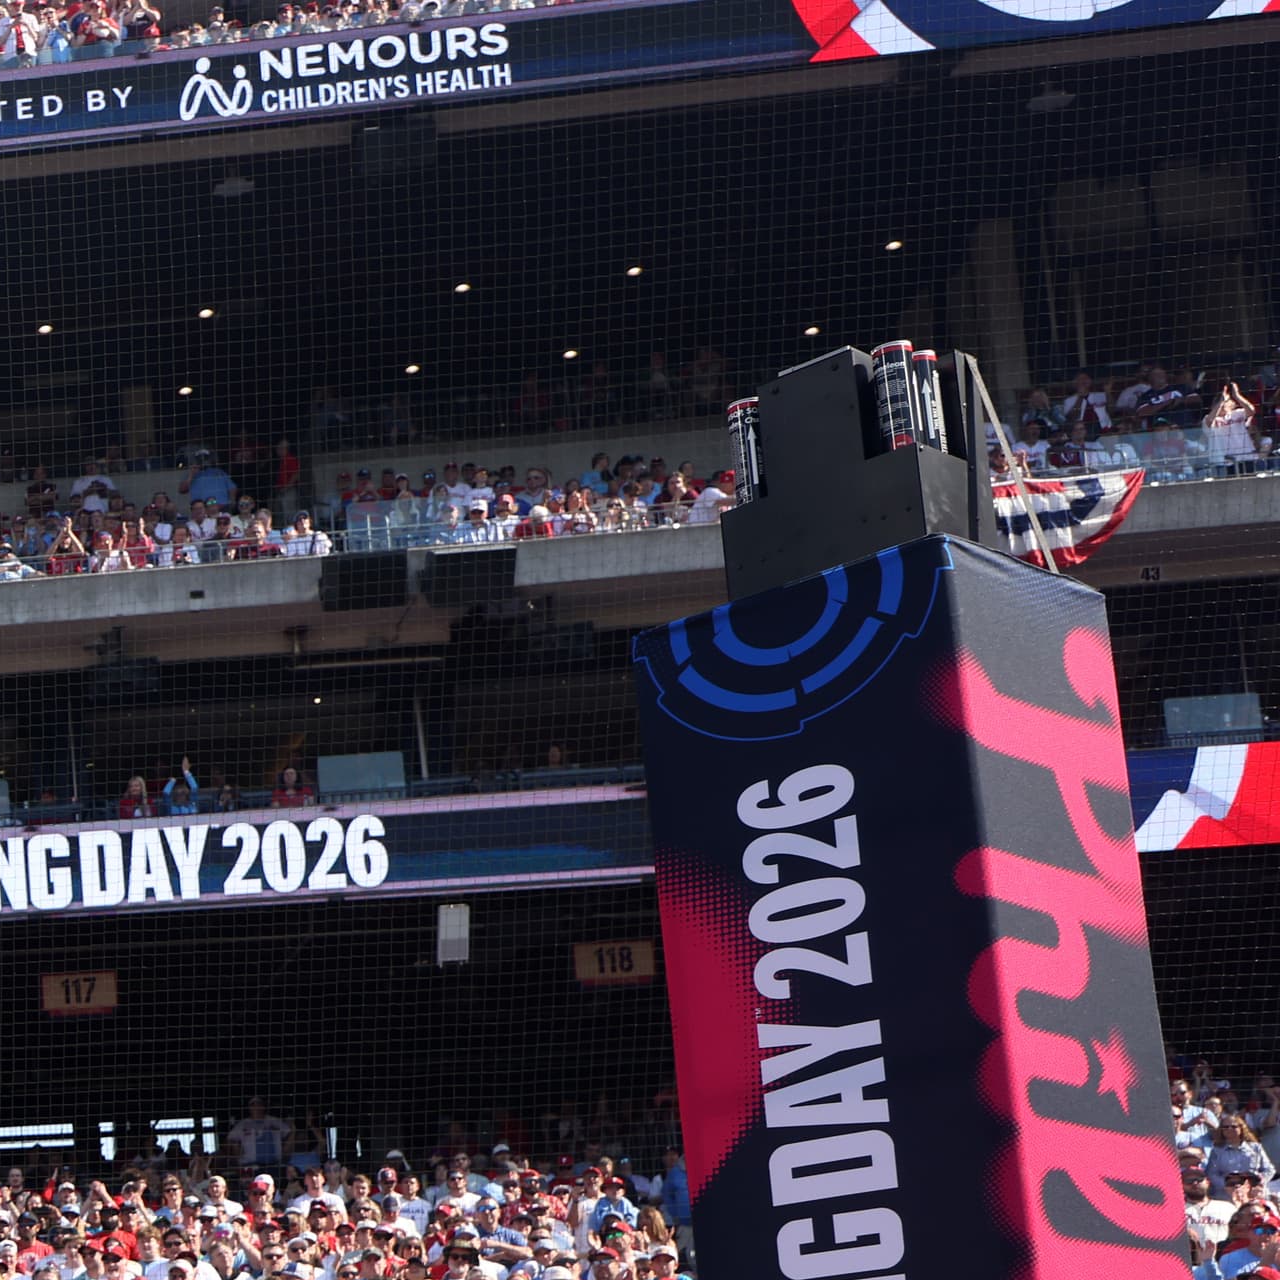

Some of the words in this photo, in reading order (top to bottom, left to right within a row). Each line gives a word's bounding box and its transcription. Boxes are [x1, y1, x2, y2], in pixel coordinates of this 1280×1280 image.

[260, 22, 510, 82] NEMOURS
[87, 85, 135, 111] BY
[260, 73, 410, 113] CHILDREN'S
[415, 63, 512, 97] HEALTH
[1141, 567, 1161, 581] 43
[81, 823, 208, 907] DAY
[222, 814, 389, 896] 2026
[736, 763, 873, 1000] 2026
[593, 946, 634, 974] 118
[61, 976, 97, 1005] 117
[756, 1018, 899, 1207] DAY
